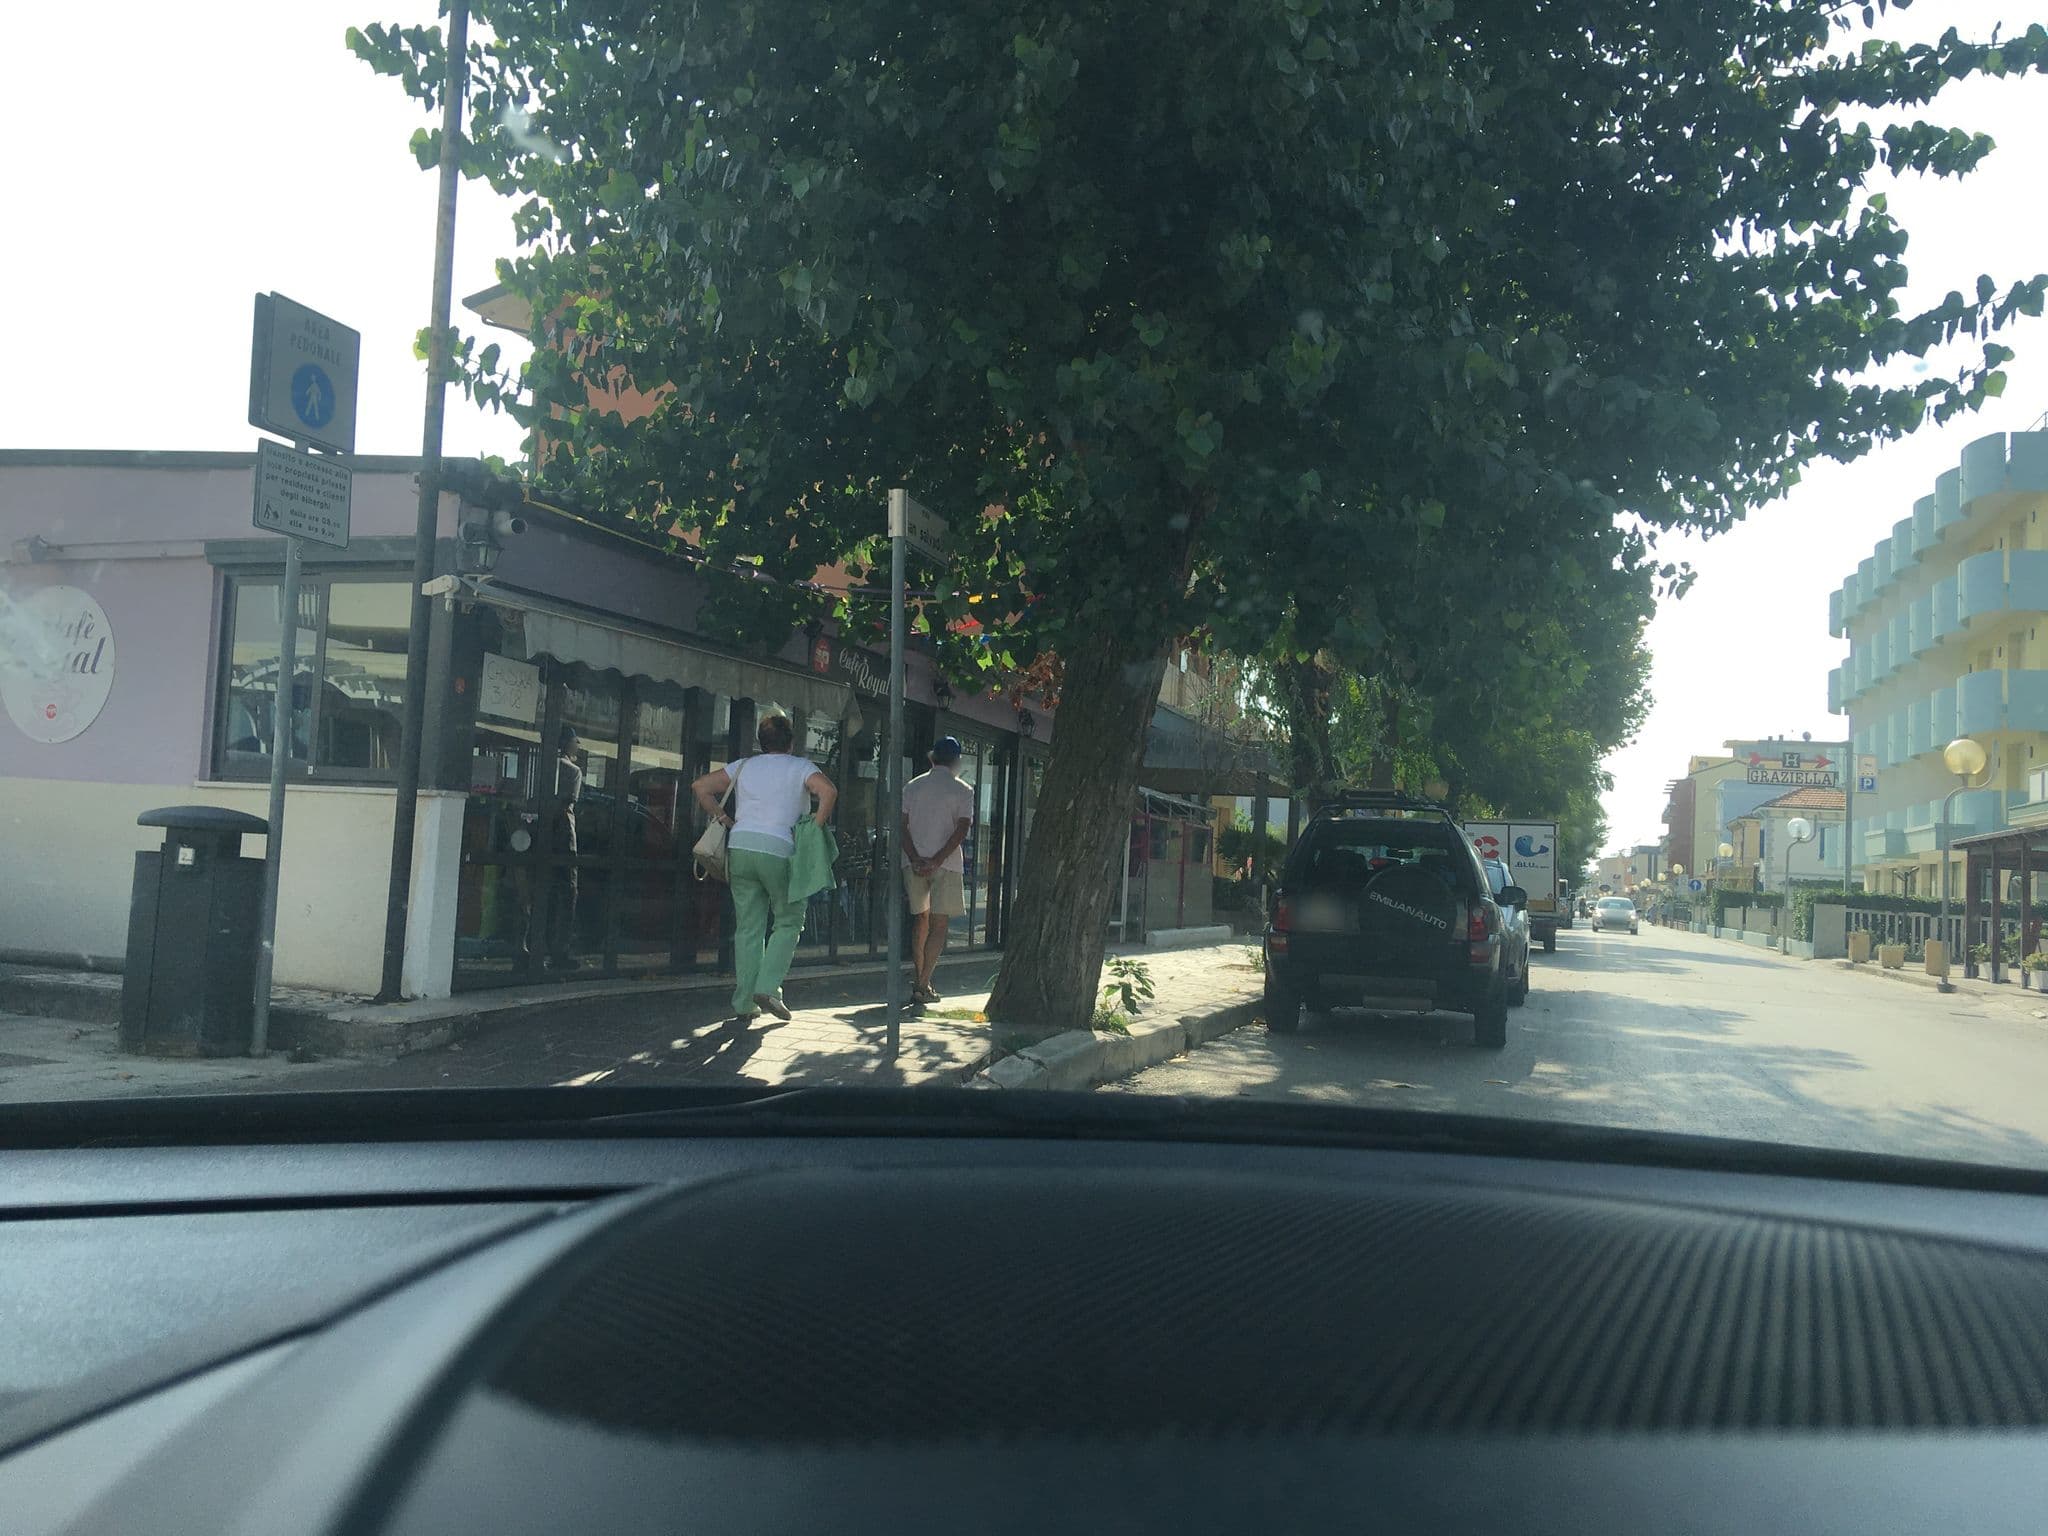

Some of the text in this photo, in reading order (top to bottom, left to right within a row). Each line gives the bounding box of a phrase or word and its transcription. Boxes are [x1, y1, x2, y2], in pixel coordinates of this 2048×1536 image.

[281, 478, 314, 493] residenti
[301, 495, 331, 511] alberghi
[856, 661, 893, 698] Royal
[1750, 770, 1832, 786] GRAZIELLA
